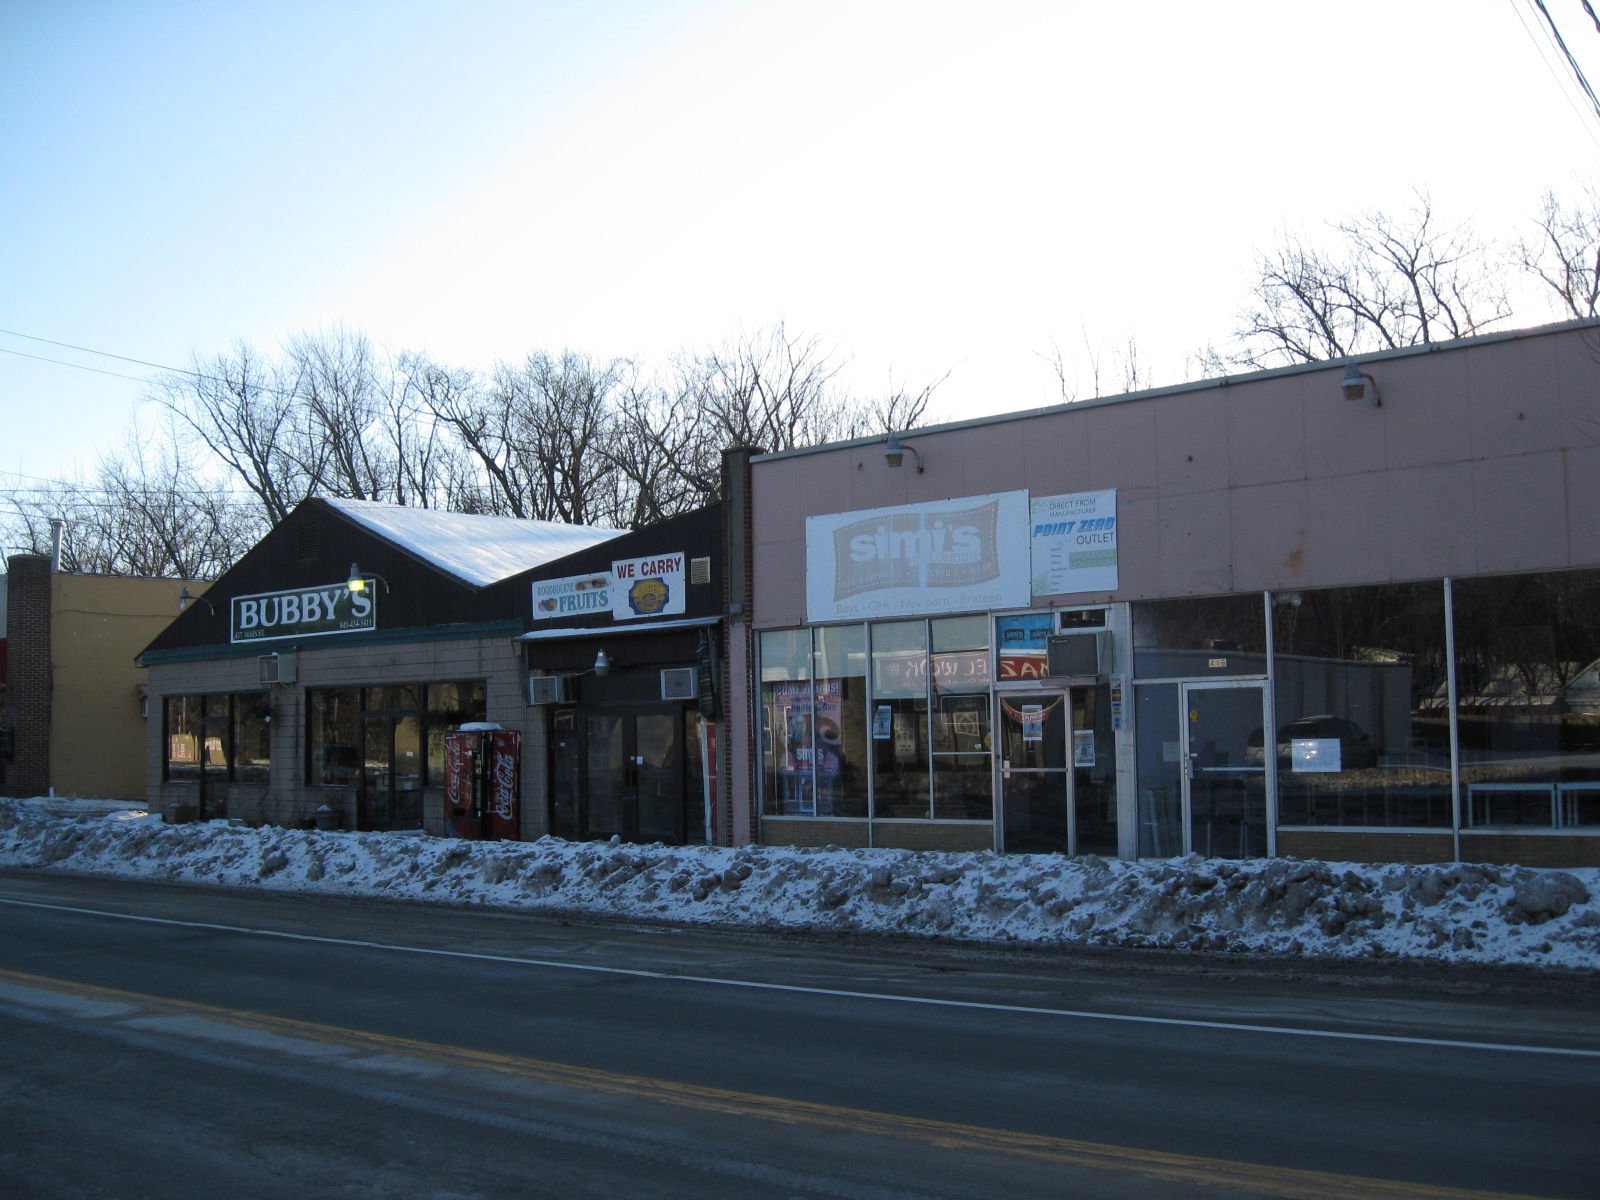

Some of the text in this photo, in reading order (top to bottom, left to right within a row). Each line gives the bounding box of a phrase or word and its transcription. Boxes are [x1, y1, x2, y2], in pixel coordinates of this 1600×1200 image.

[1050, 499, 1096, 510] DIRECT FROM
[1033, 517, 1115, 537] POINT ZERO
[1076, 532, 1114, 545] OUTLET
[617, 557, 682, 579] WE CARRY
[240, 587, 371, 629] BUBBY'S
[559, 591, 608, 612] FRUITS
